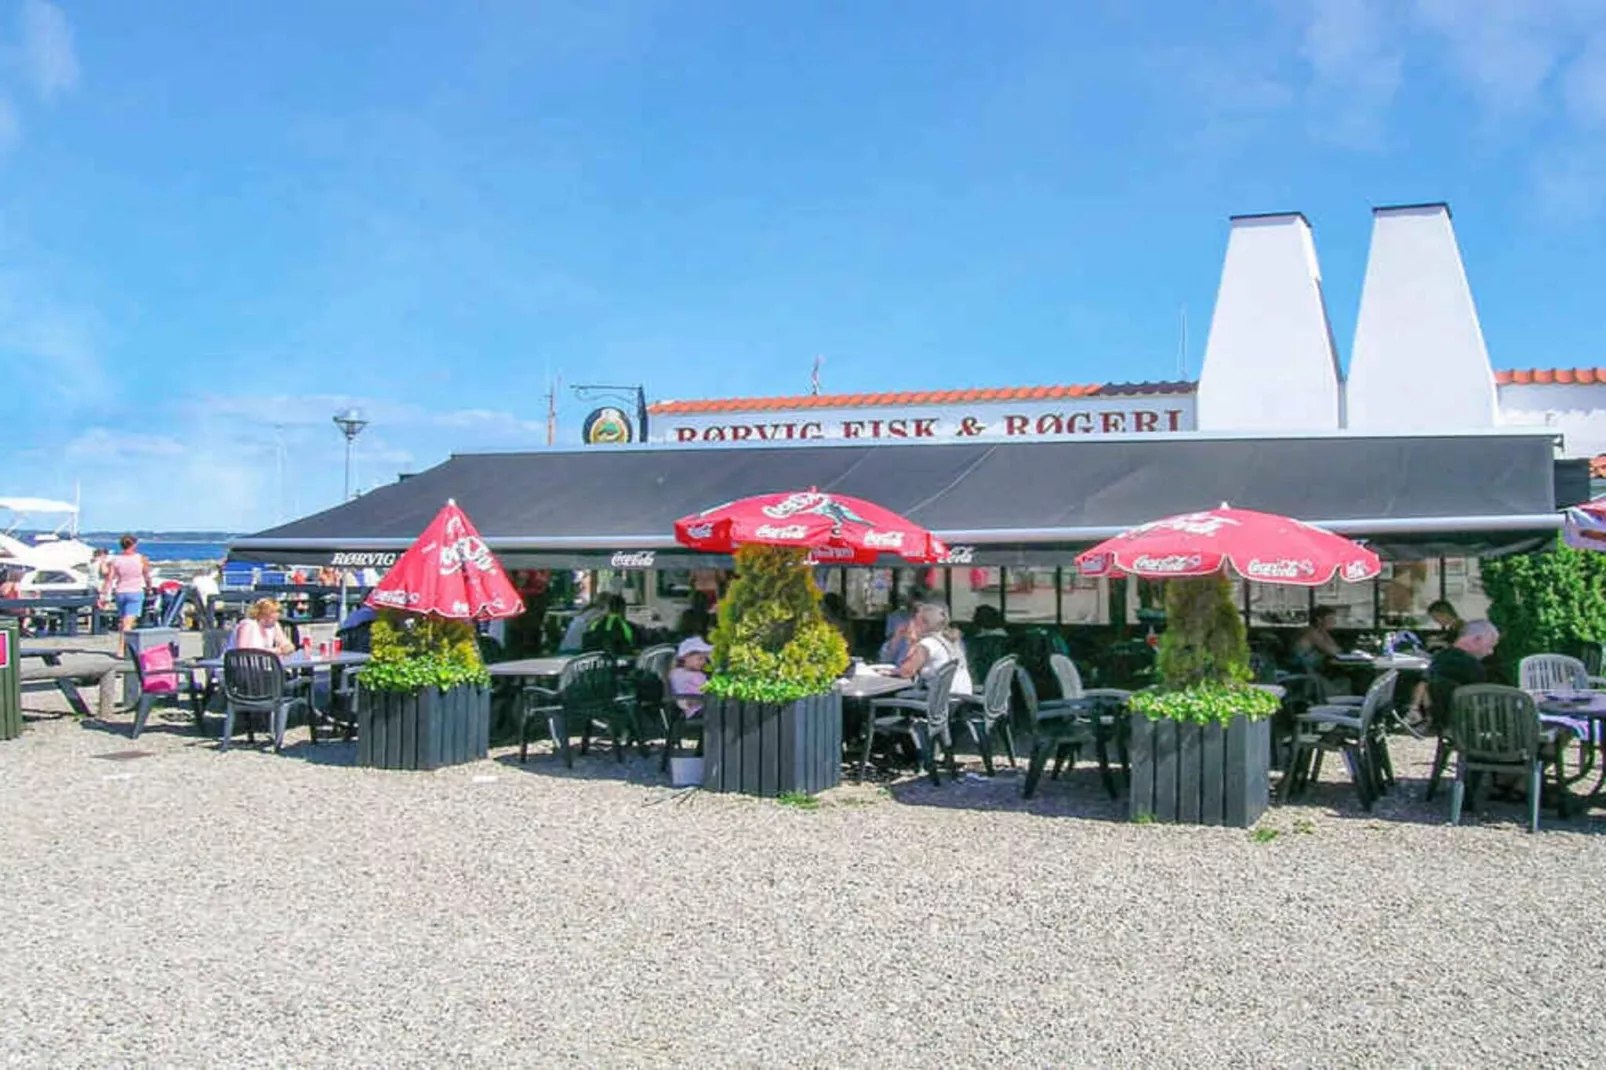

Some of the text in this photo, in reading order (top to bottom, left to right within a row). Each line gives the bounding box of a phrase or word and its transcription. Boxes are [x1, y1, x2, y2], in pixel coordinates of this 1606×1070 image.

[840, 417, 940, 438] FISK
[956, 415, 986, 436] &
[1003, 408, 1183, 435] RØGERI
[331, 552, 397, 566] RØRVIG
